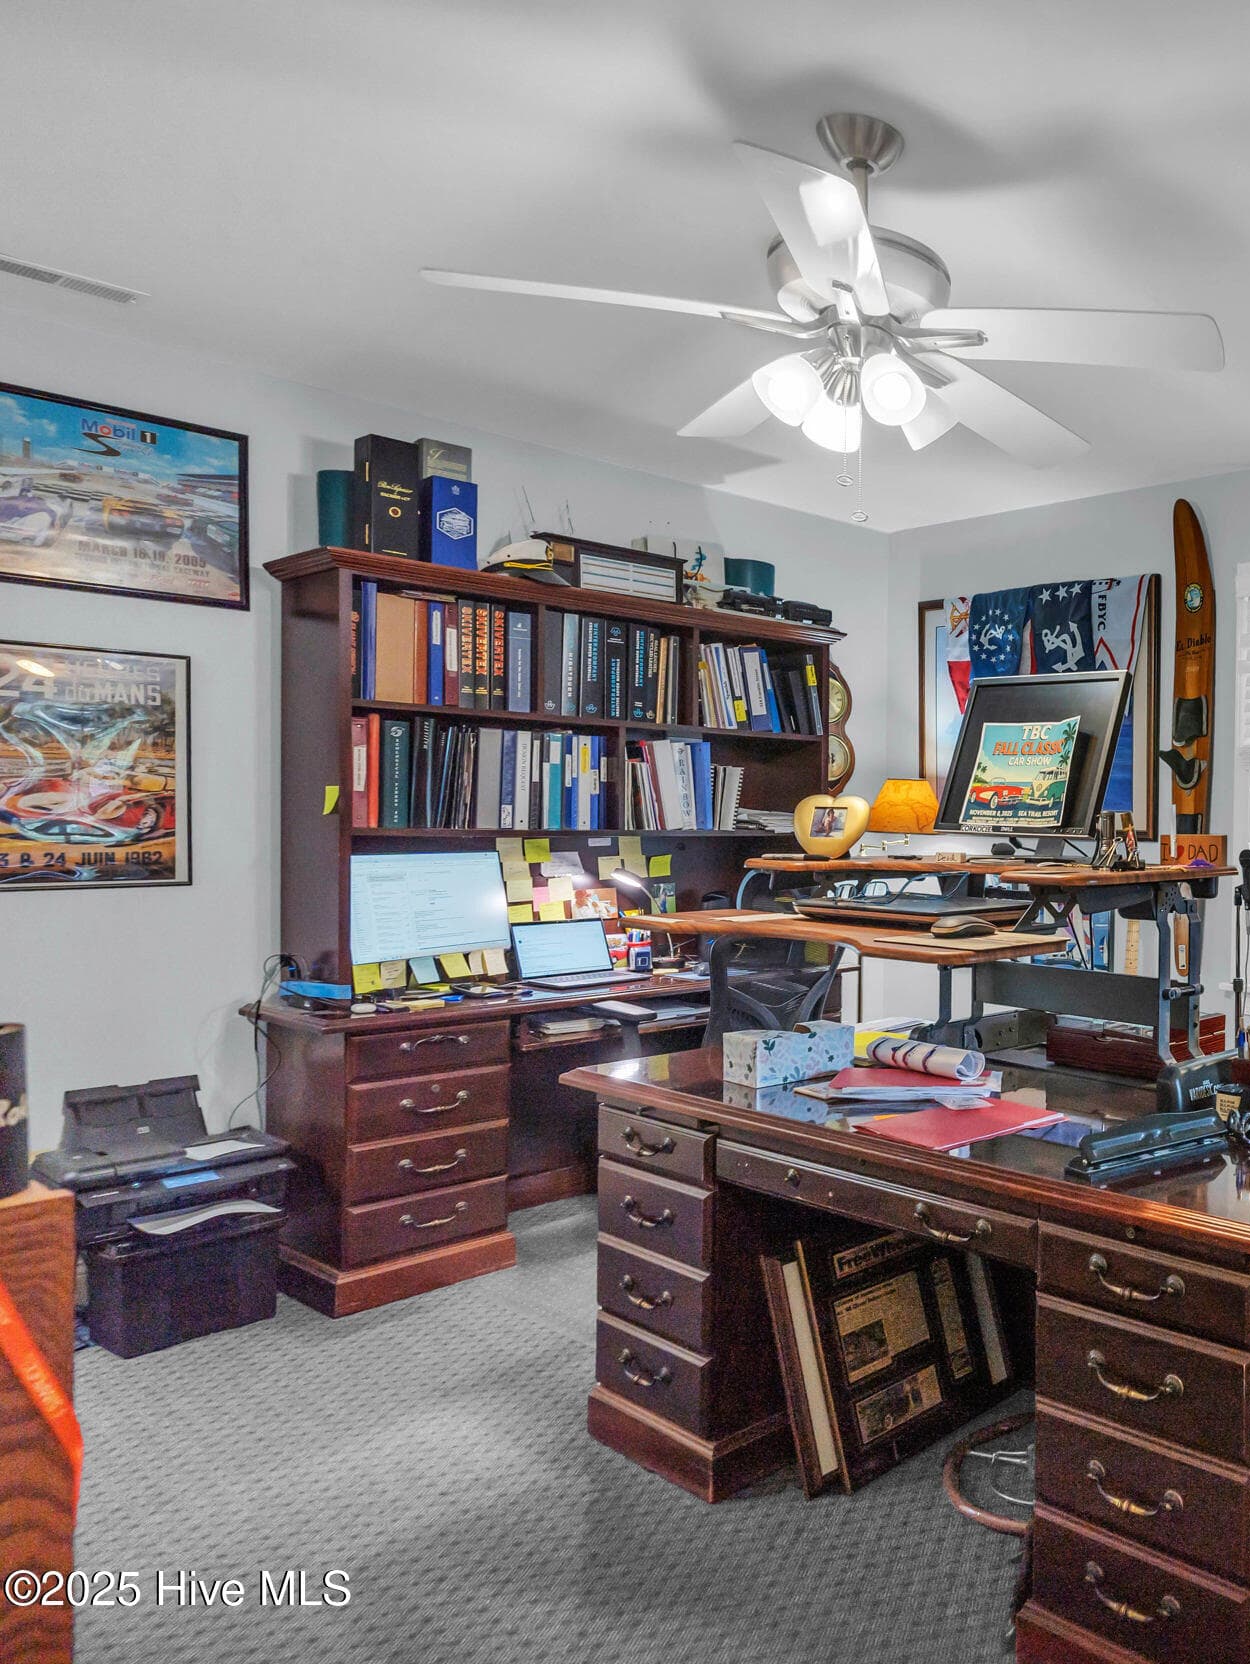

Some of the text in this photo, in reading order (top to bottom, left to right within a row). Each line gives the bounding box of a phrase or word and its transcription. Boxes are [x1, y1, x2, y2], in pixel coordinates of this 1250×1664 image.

[82, 418, 137, 442] Mobil
[143, 431, 154, 444] 1
[1097, 594, 1107, 632] FBYC
[494, 610, 505, 677] SKIVERTEX
[93, 681, 162, 706] MANS
[1022, 725, 1052, 740] TBC
[992, 741, 1020, 755] FALL
[1008, 756, 1053, 767] CAR SHOW
[44, 852, 66, 868] 24
[75, 851, 116, 867] JUIN
[1188, 844, 1218, 863] DAD
